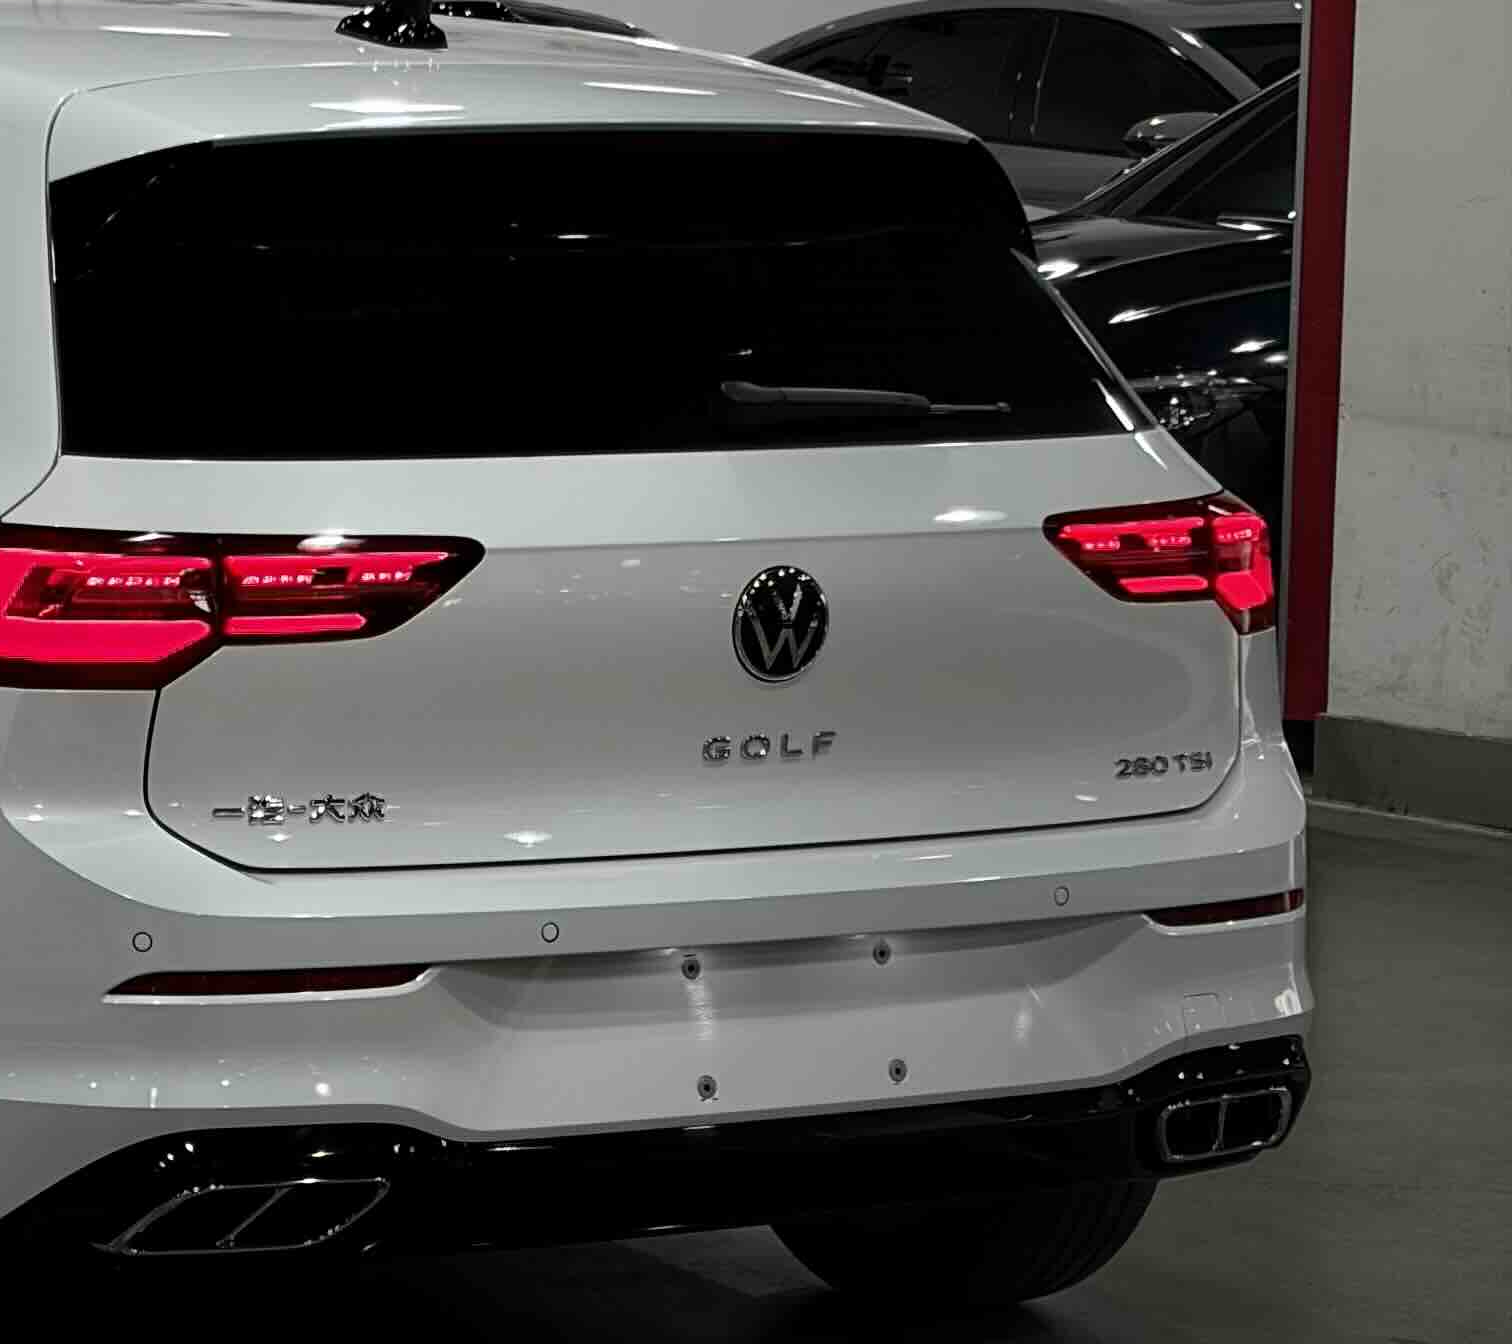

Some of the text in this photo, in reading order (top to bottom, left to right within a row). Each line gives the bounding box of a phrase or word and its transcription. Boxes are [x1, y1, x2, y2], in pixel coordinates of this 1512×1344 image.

[702, 729, 837, 761] GOLF
[1113, 751, 1213, 779] 280 TSI
